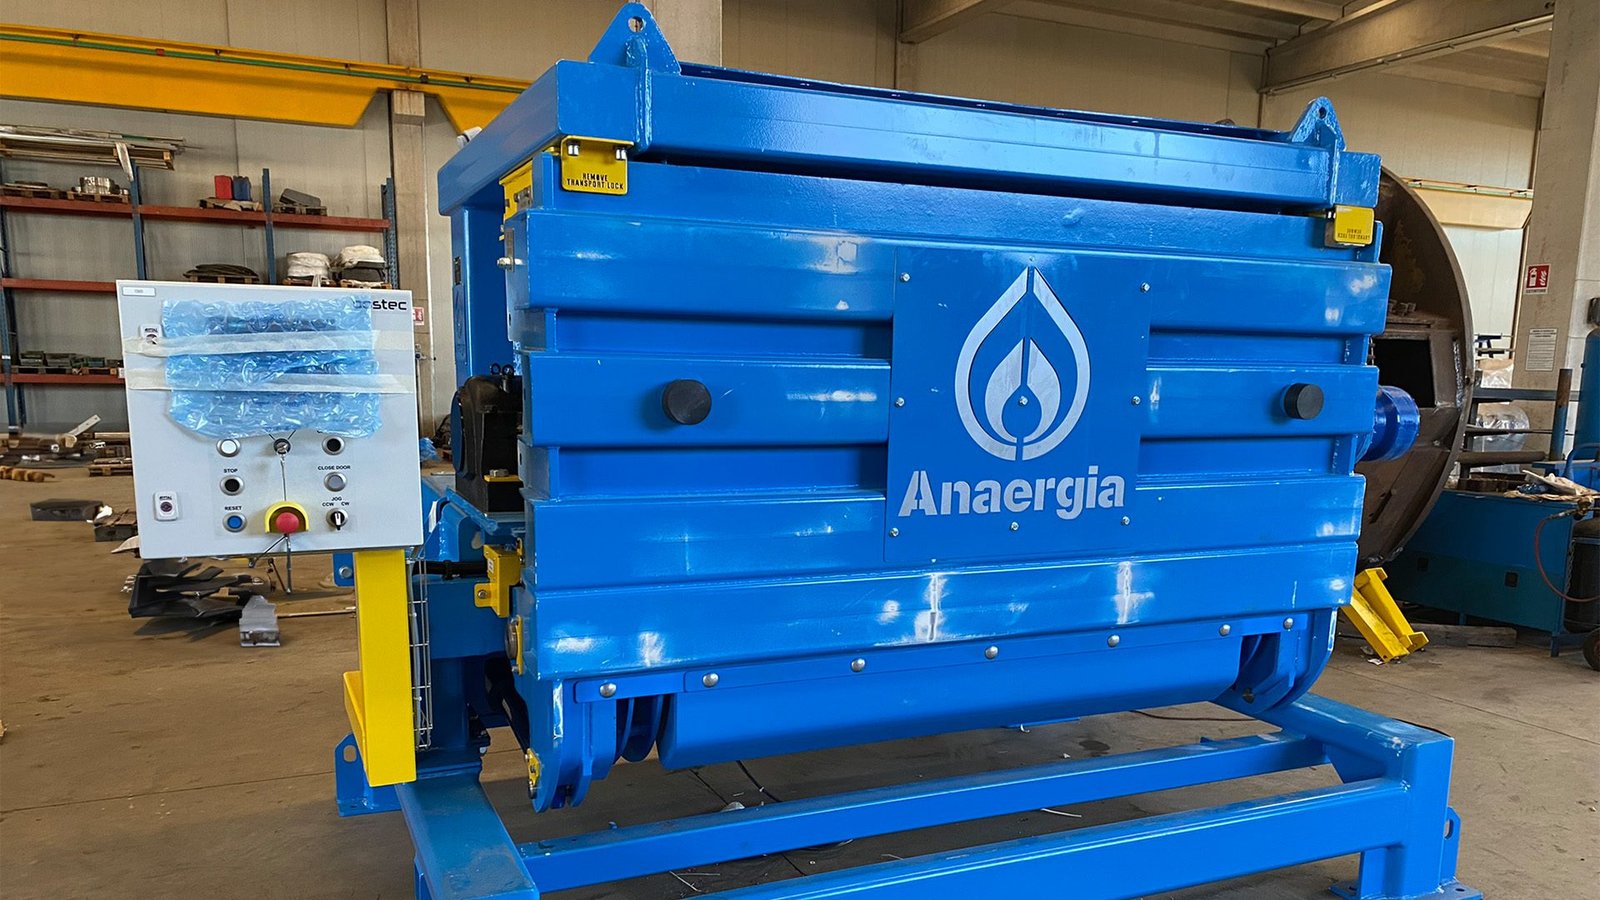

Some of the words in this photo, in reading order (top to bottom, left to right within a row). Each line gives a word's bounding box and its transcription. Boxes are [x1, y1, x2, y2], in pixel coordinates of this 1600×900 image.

[583, 173, 608, 181] REMOVE
[567, 178, 605, 188] TRANSPORT
[607, 182, 624, 190] LOCK
[898, 465, 1125, 520] Anaergia
